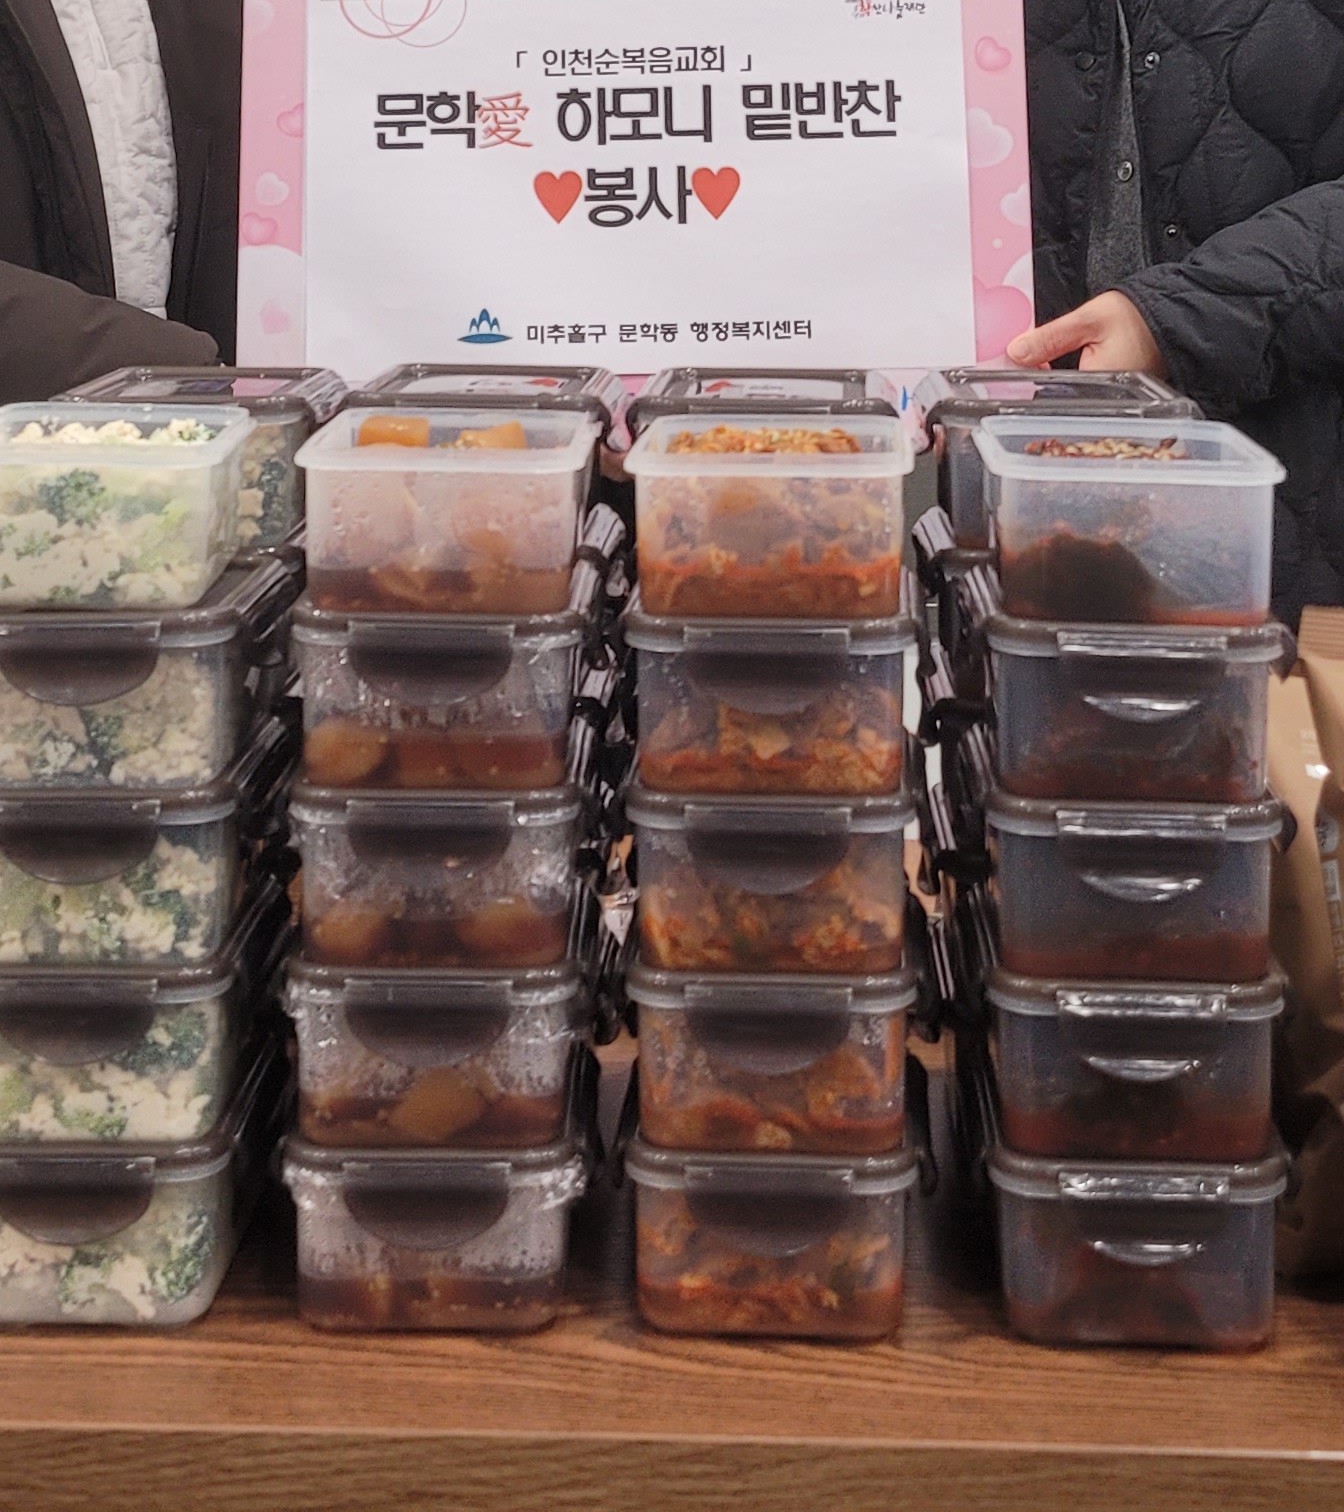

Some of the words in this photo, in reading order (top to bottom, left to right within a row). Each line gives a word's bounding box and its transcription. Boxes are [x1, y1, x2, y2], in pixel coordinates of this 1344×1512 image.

[542, 45, 726, 76] 인천순복음교회
[556, 84, 714, 146] 하모니
[741, 79, 902, 141] 밑반찬
[583, 165, 692, 229] 봉사
[526, 323, 607, 345] 미추홀구
[618, 322, 679, 344] 문학동
[690, 319, 813, 342] 행정복지센터
